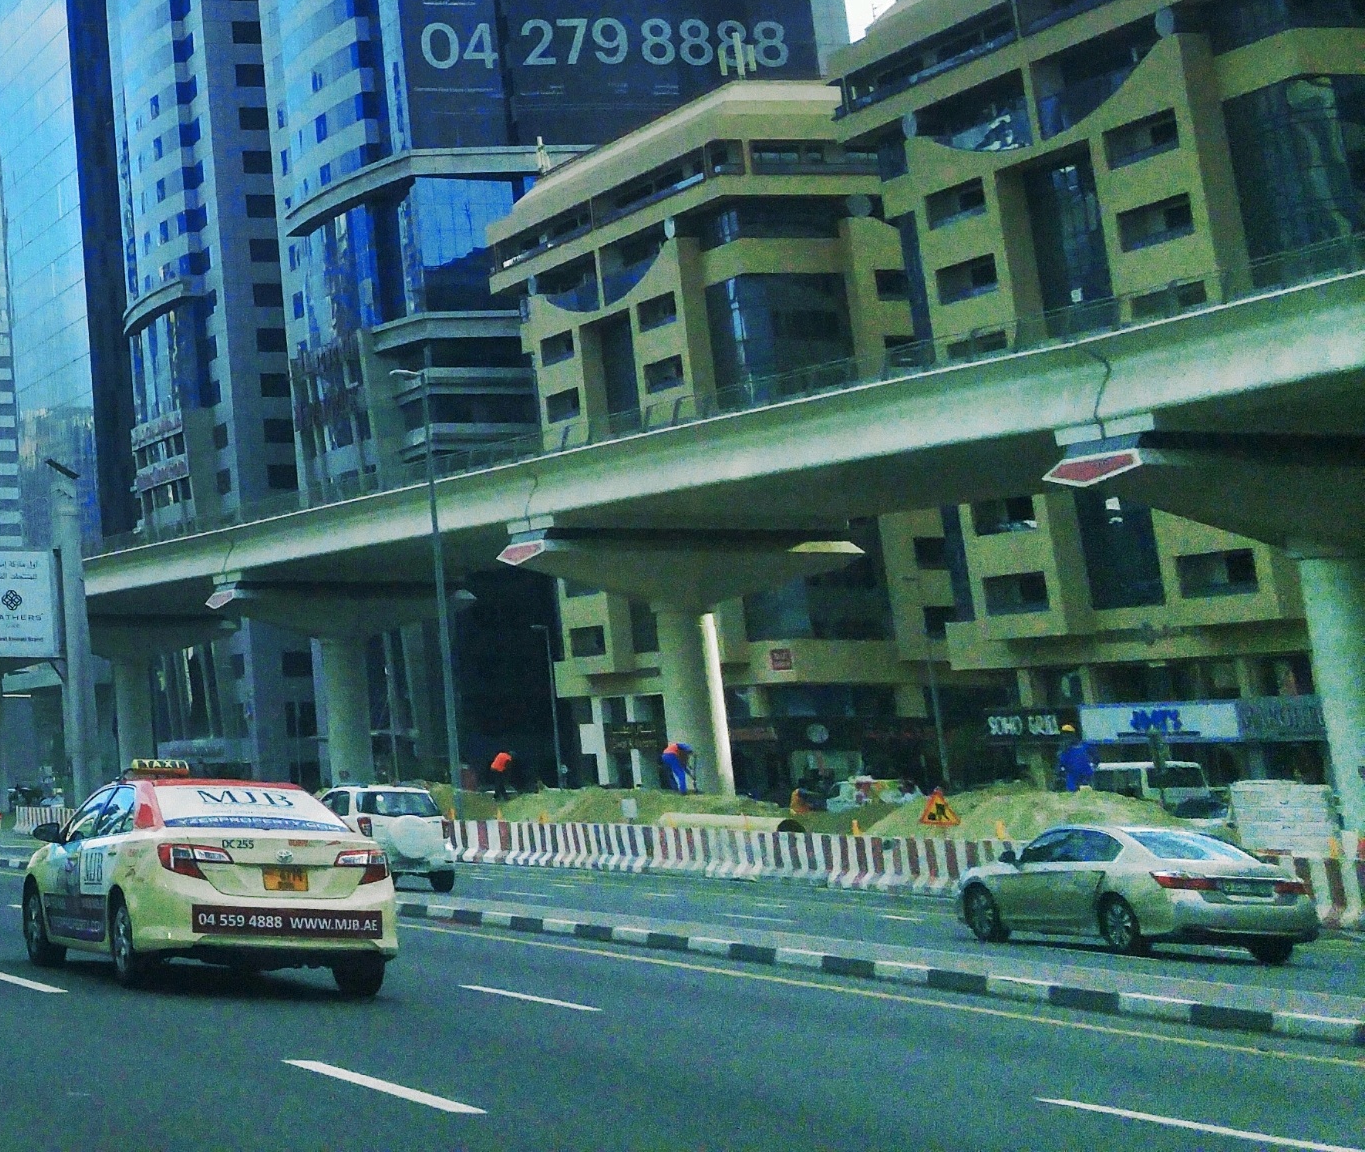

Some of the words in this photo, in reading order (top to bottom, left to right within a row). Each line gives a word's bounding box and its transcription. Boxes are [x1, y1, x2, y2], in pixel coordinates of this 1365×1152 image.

[421, 22, 499, 69] 04
[521, 17, 629, 66] 279
[640, 18, 790, 67] 8888
[141, 759, 180, 769] TAXI
[197, 789, 295, 808] MJB
[198, 912, 216, 926] 04
[219, 914, 245, 927] 559
[248, 915, 283, 929] 4888
[290, 916, 378, 932] WWW.MJB.AE
